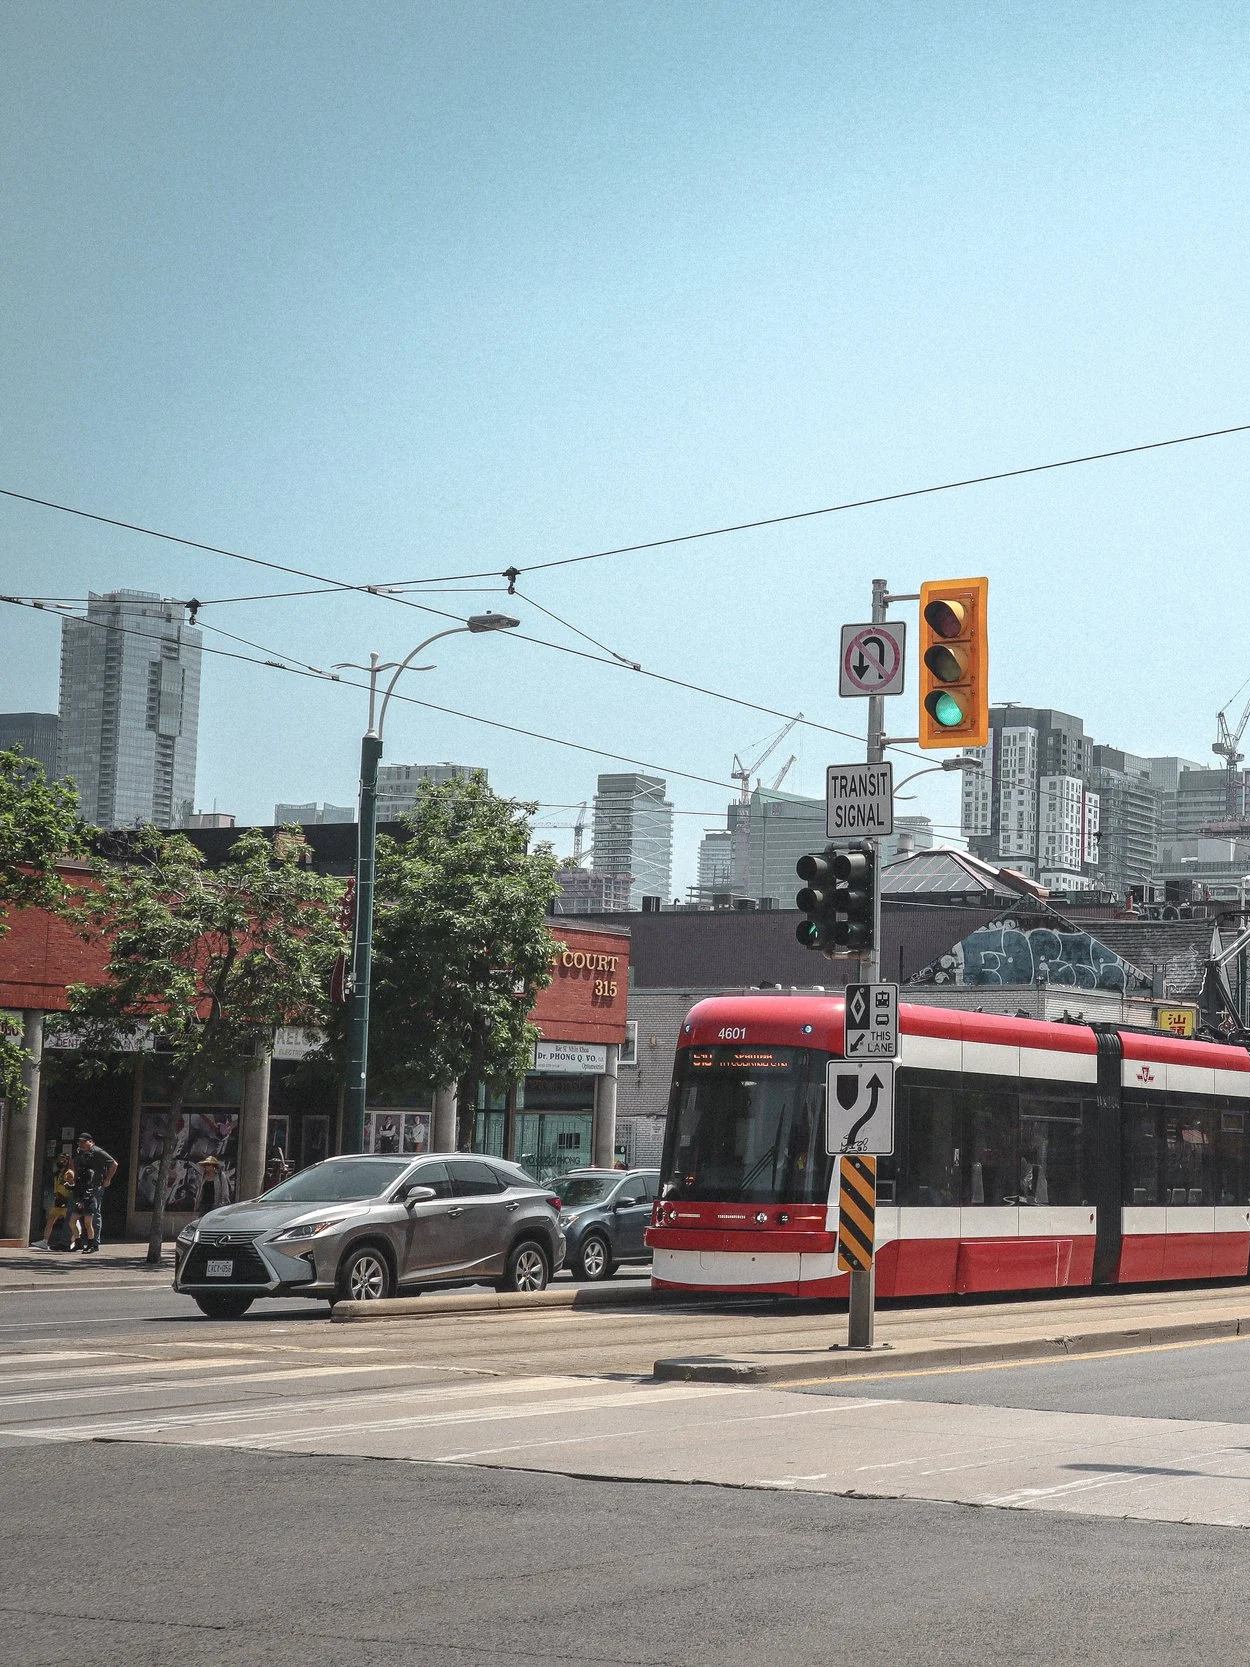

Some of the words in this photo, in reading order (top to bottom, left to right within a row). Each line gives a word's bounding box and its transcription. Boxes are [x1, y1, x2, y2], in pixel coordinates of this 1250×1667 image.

[831, 772, 888, 799] TRANSIT
[834, 803, 885, 828] SIGNAL
[562, 951, 619, 972] COURT
[595, 979, 618, 997] 315
[718, 1027, 747, 1040] 4601
[870, 1031, 891, 1041] THIS
[867, 1043, 894, 1053] LANE
[537, 1052, 548, 1060] Dr.
[549, 1053, 576, 1061] PHONG
